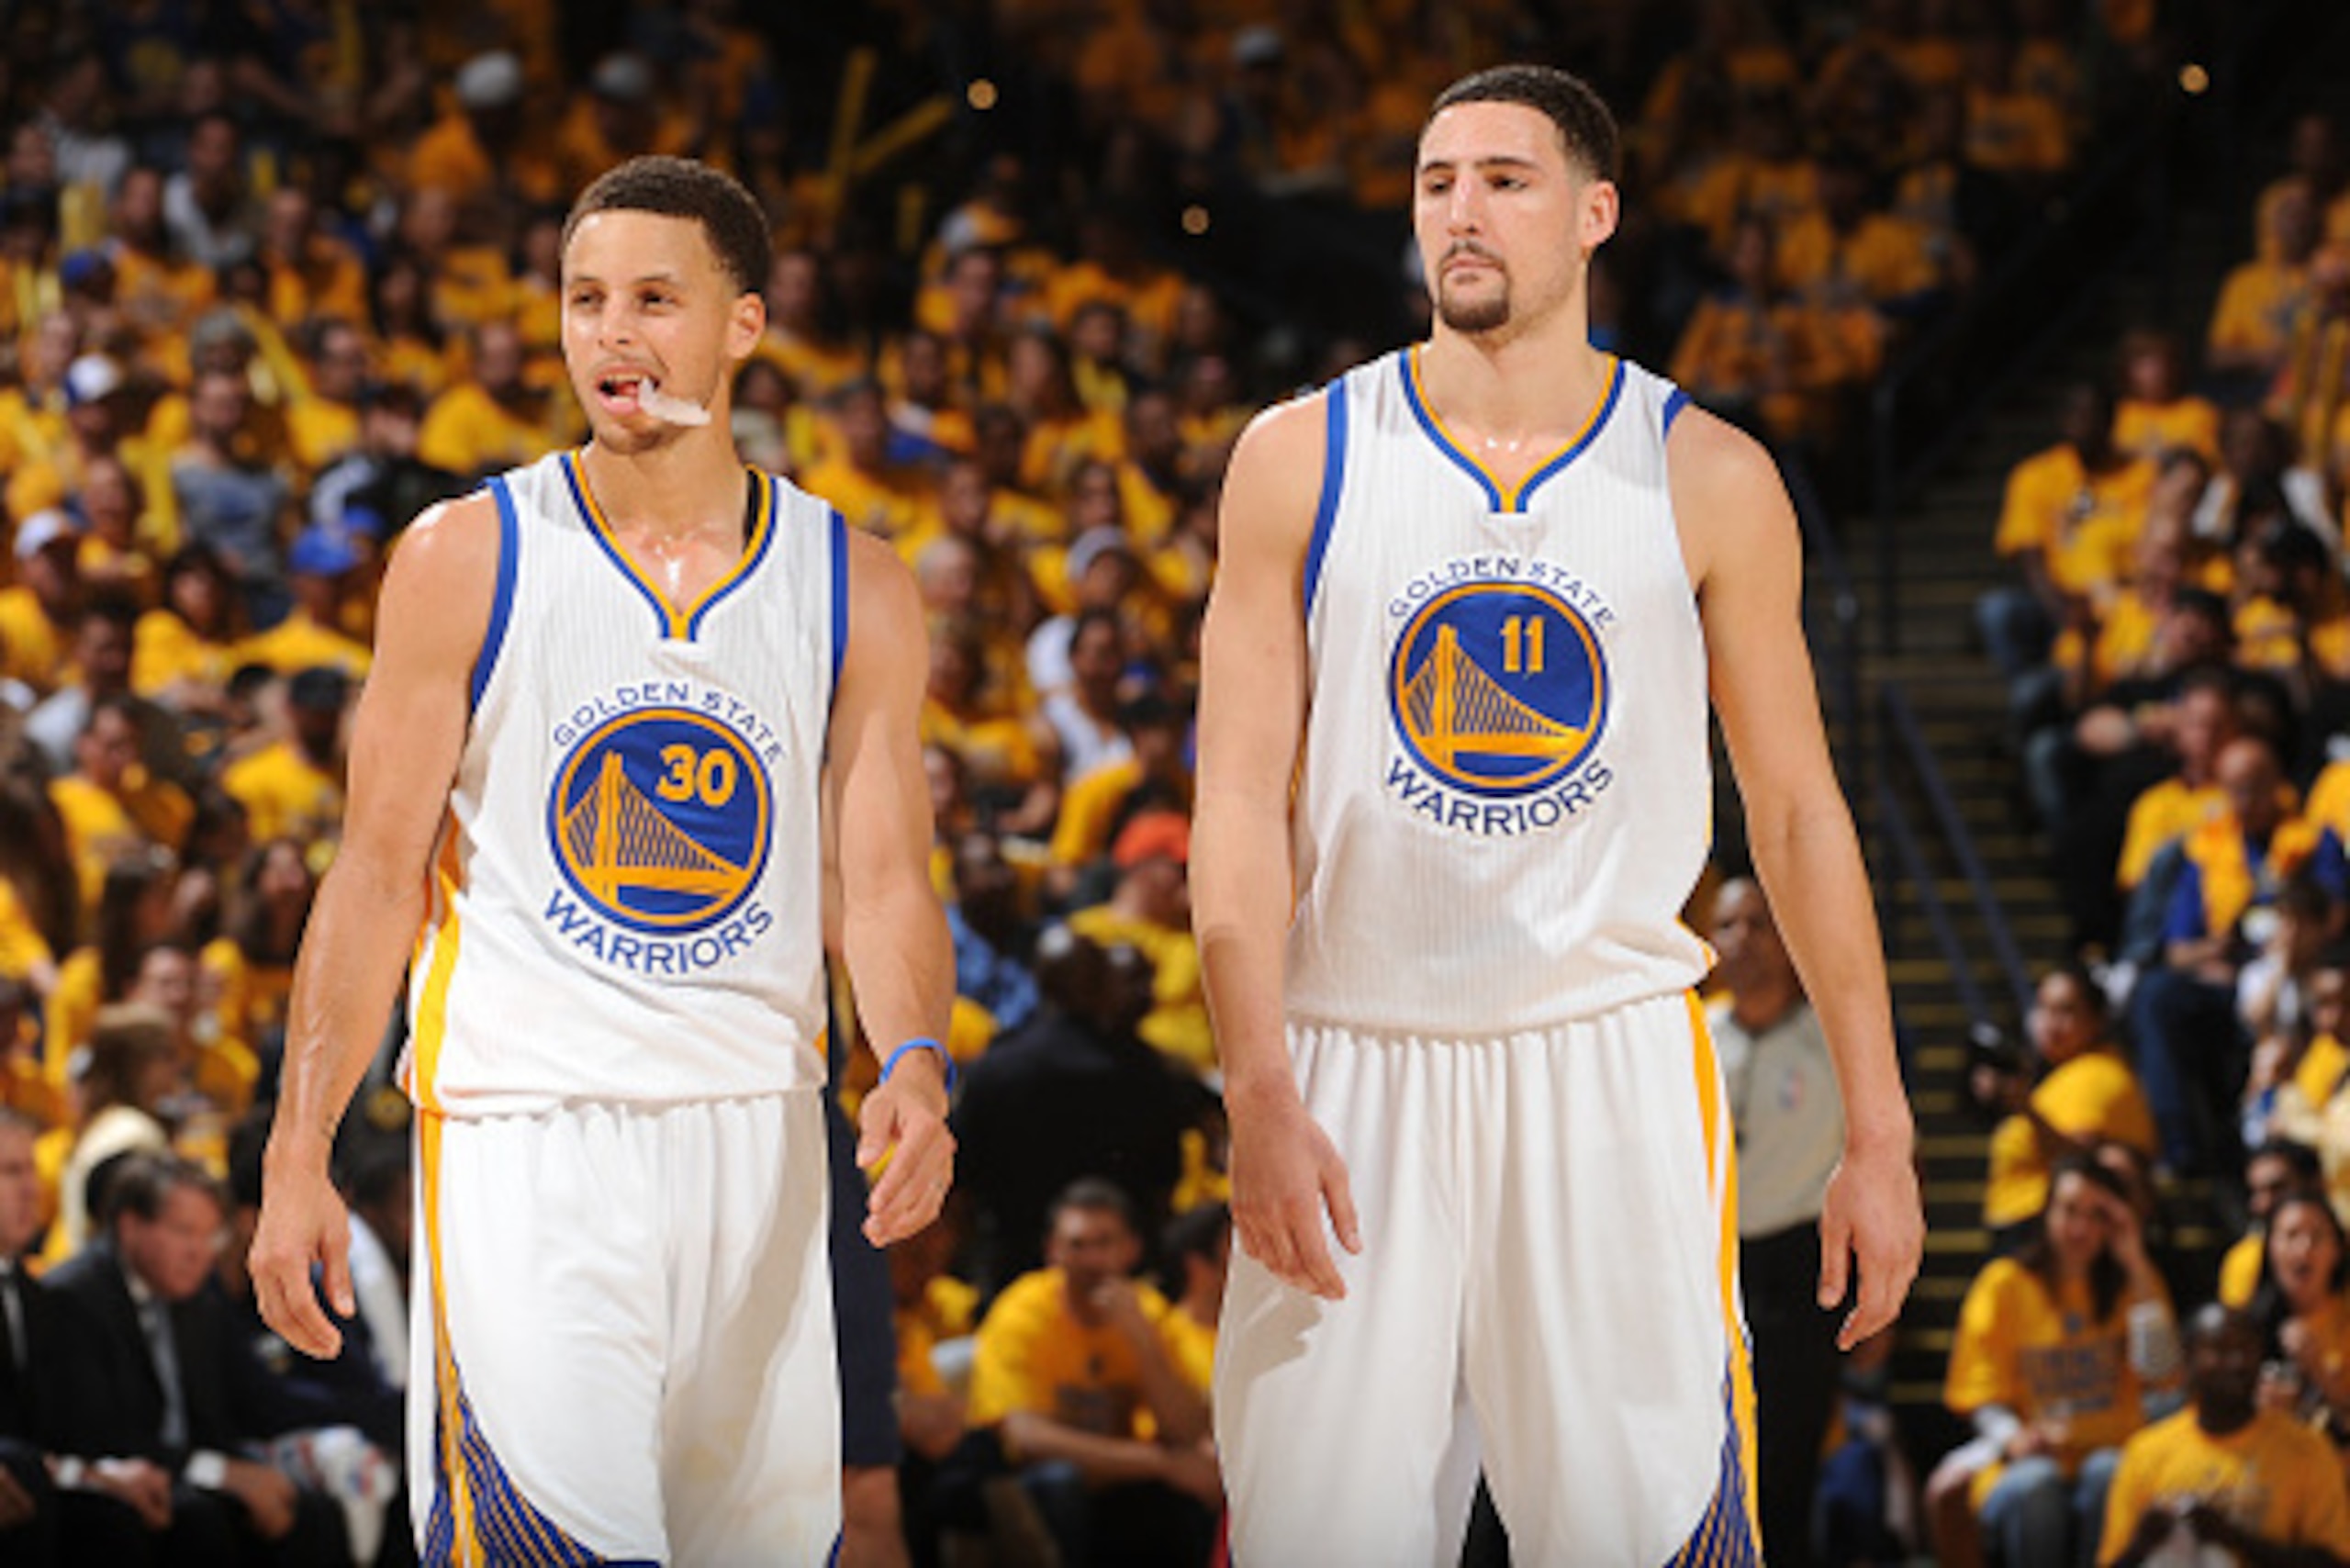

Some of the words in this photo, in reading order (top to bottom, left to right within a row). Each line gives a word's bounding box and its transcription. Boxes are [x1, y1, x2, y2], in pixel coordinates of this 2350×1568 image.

[1389, 557, 1519, 618] GOLDEN
[1528, 562, 1616, 630] STATE
[1499, 615, 1544, 673] 11
[553, 683, 688, 747] GOLDEN
[701, 691, 787, 764] STATE
[656, 744, 738, 807] 30
[1386, 756, 1613, 835] WARRIORS
[543, 889, 774, 975] WARRIORS
